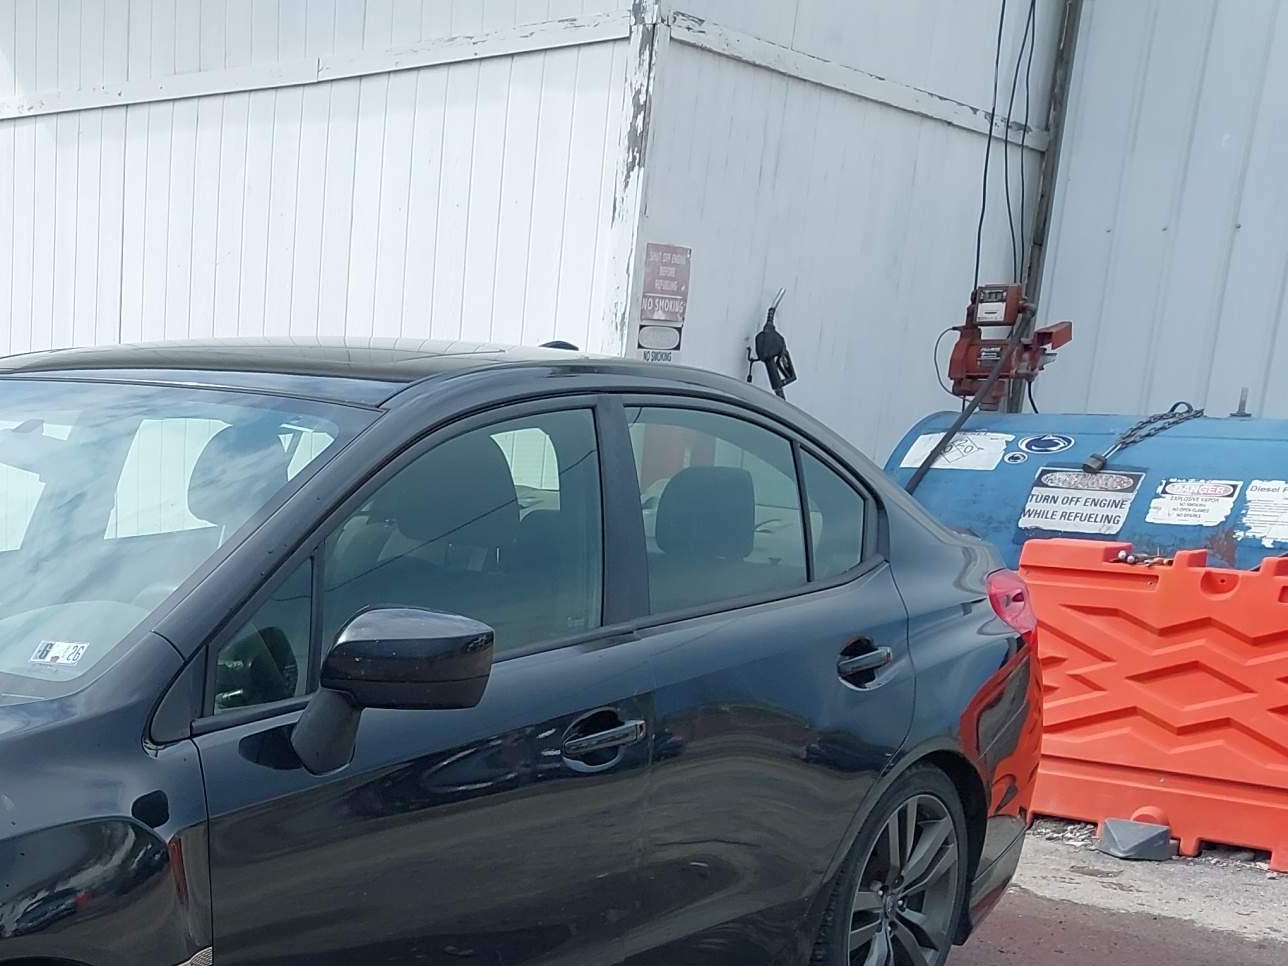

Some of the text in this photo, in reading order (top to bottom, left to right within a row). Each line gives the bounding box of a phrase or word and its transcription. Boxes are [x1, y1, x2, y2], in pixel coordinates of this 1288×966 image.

[641, 297, 685, 313] NO SMOKING
[1249, 485, 1281, 493] Diesel
[1029, 493, 1129, 509] TURN OFF ENGINE
[1023, 508, 1122, 525] WHILE REFUELING
